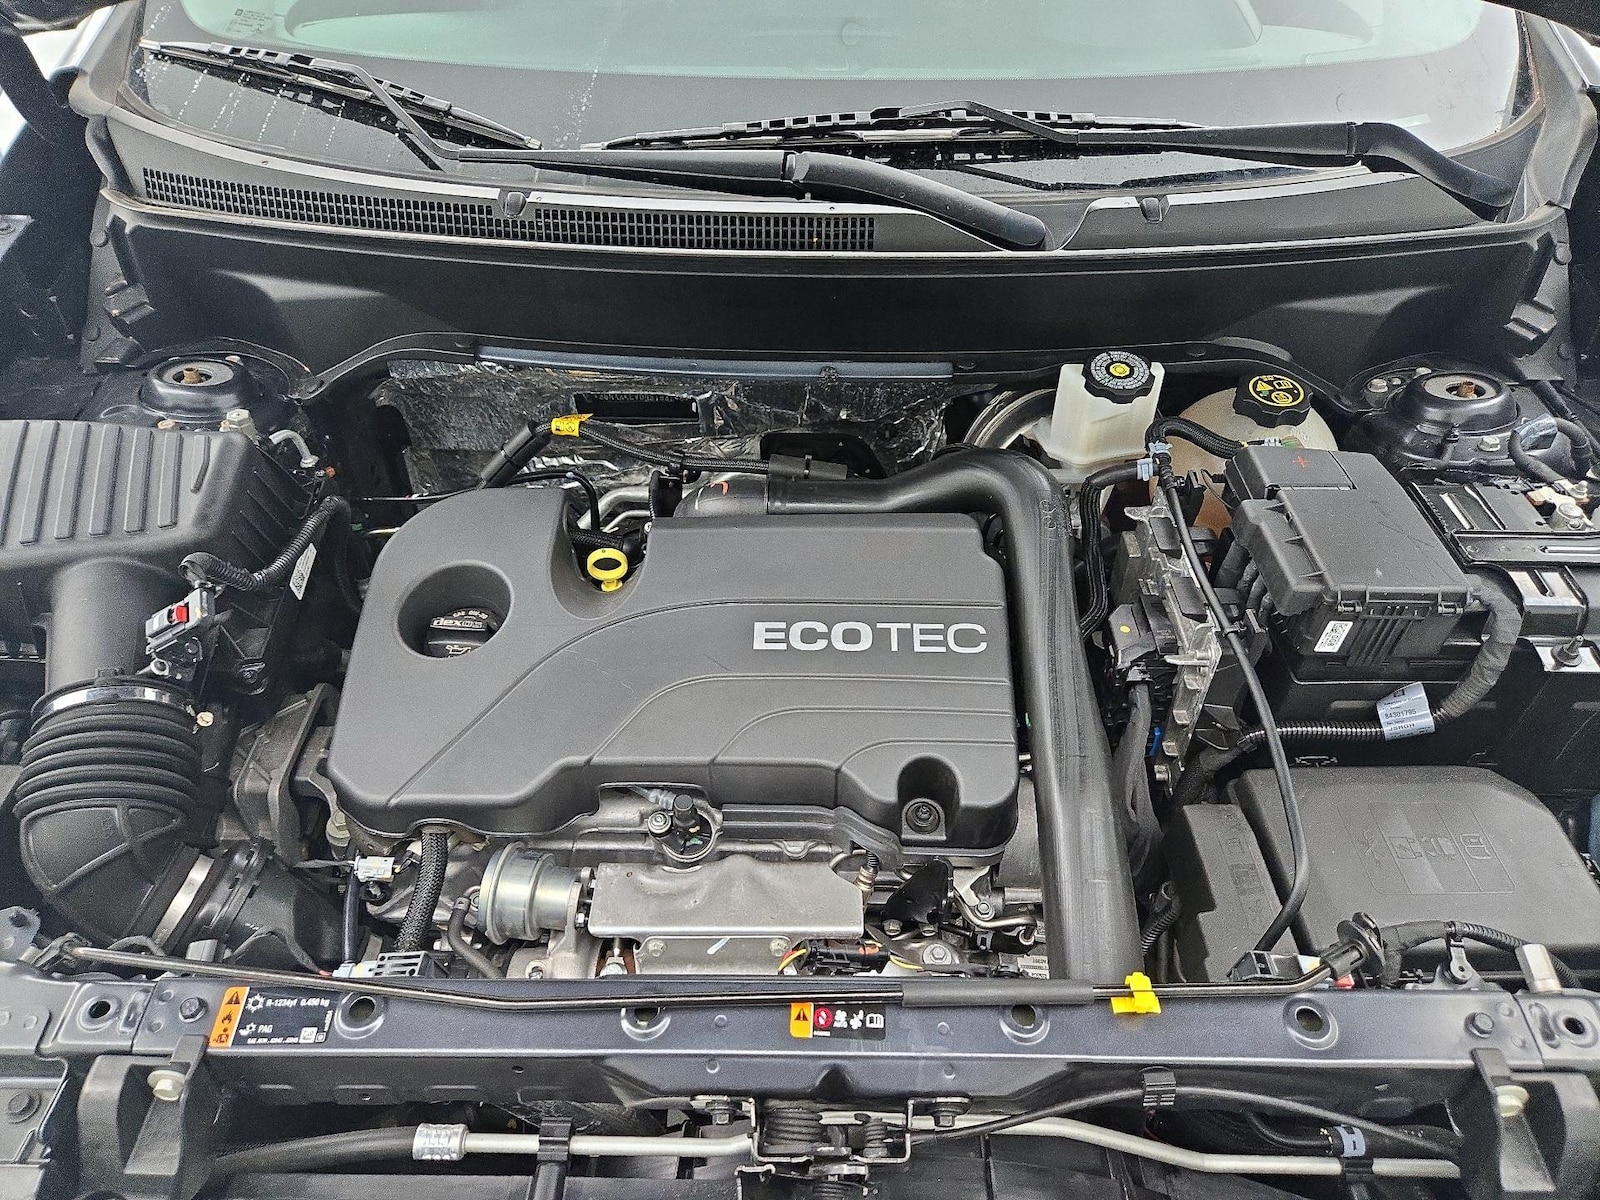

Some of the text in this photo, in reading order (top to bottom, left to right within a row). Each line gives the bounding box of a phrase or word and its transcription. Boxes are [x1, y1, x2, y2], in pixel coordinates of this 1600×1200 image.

[432, 617, 483, 629] dexos
[752, 621, 988, 654] ECOTEC
[319, 998, 330, 1008] kg
[257, 1024, 273, 1033] PAG
